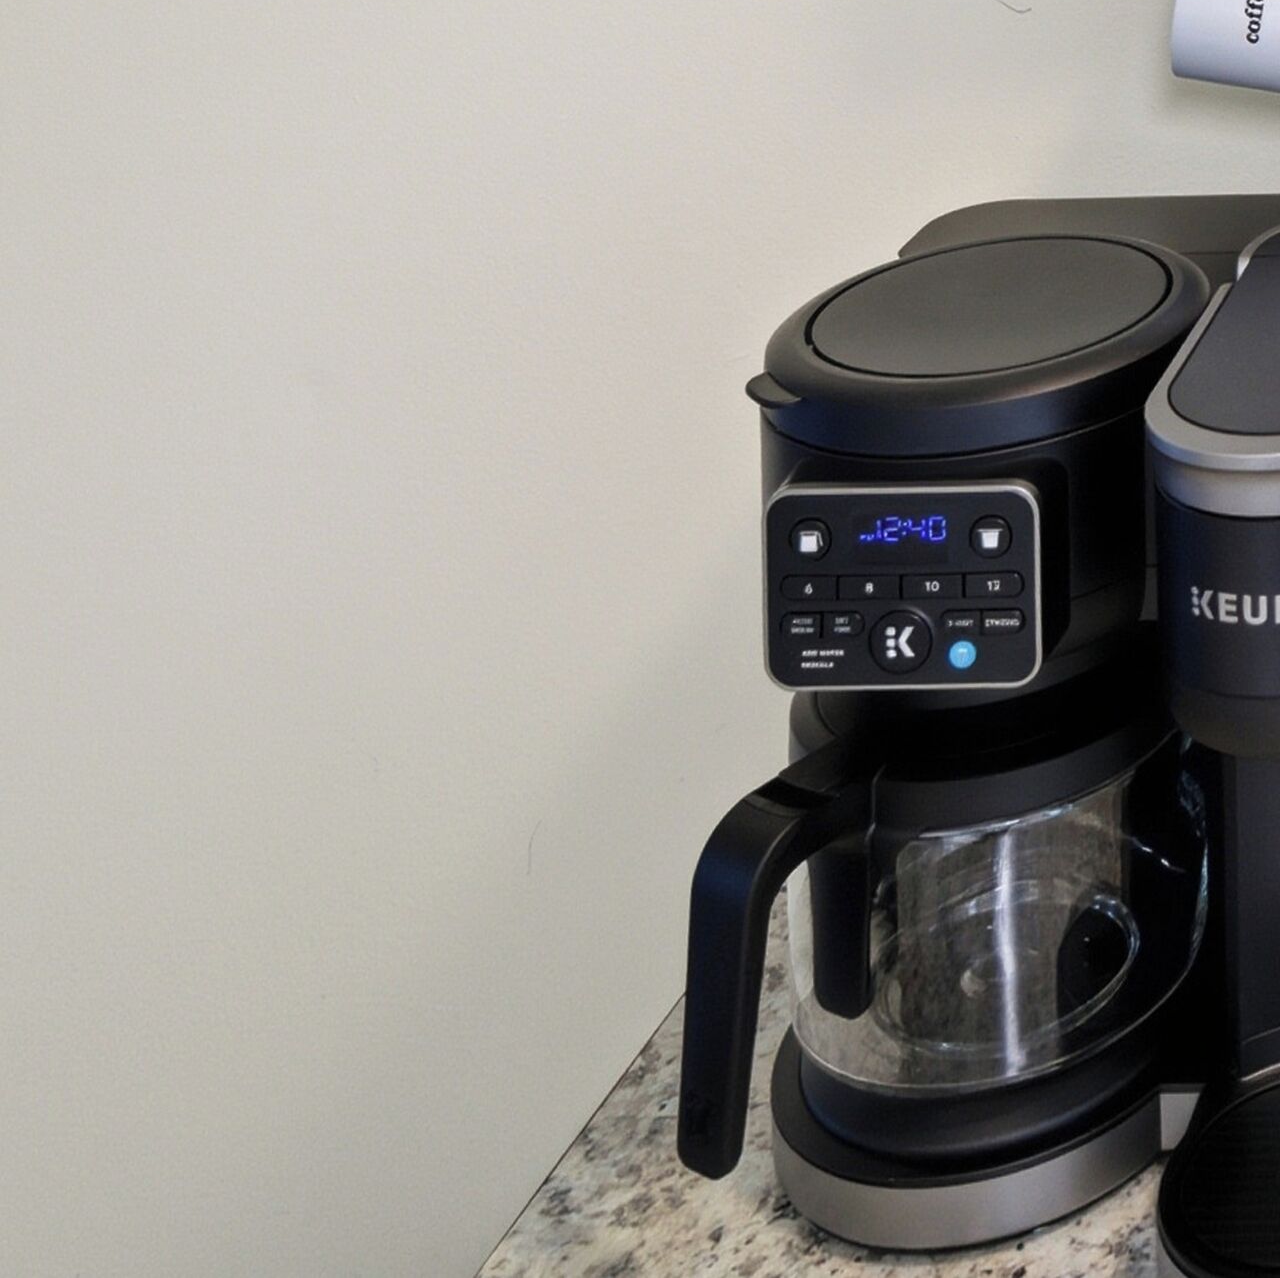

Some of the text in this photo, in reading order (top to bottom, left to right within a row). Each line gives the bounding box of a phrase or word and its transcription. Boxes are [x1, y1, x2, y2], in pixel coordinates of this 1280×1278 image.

[876, 517, 946, 542] 12:40
[804, 583, 813, 595] 6
[865, 582, 874, 594] 8
[925, 581, 940, 592] 10
